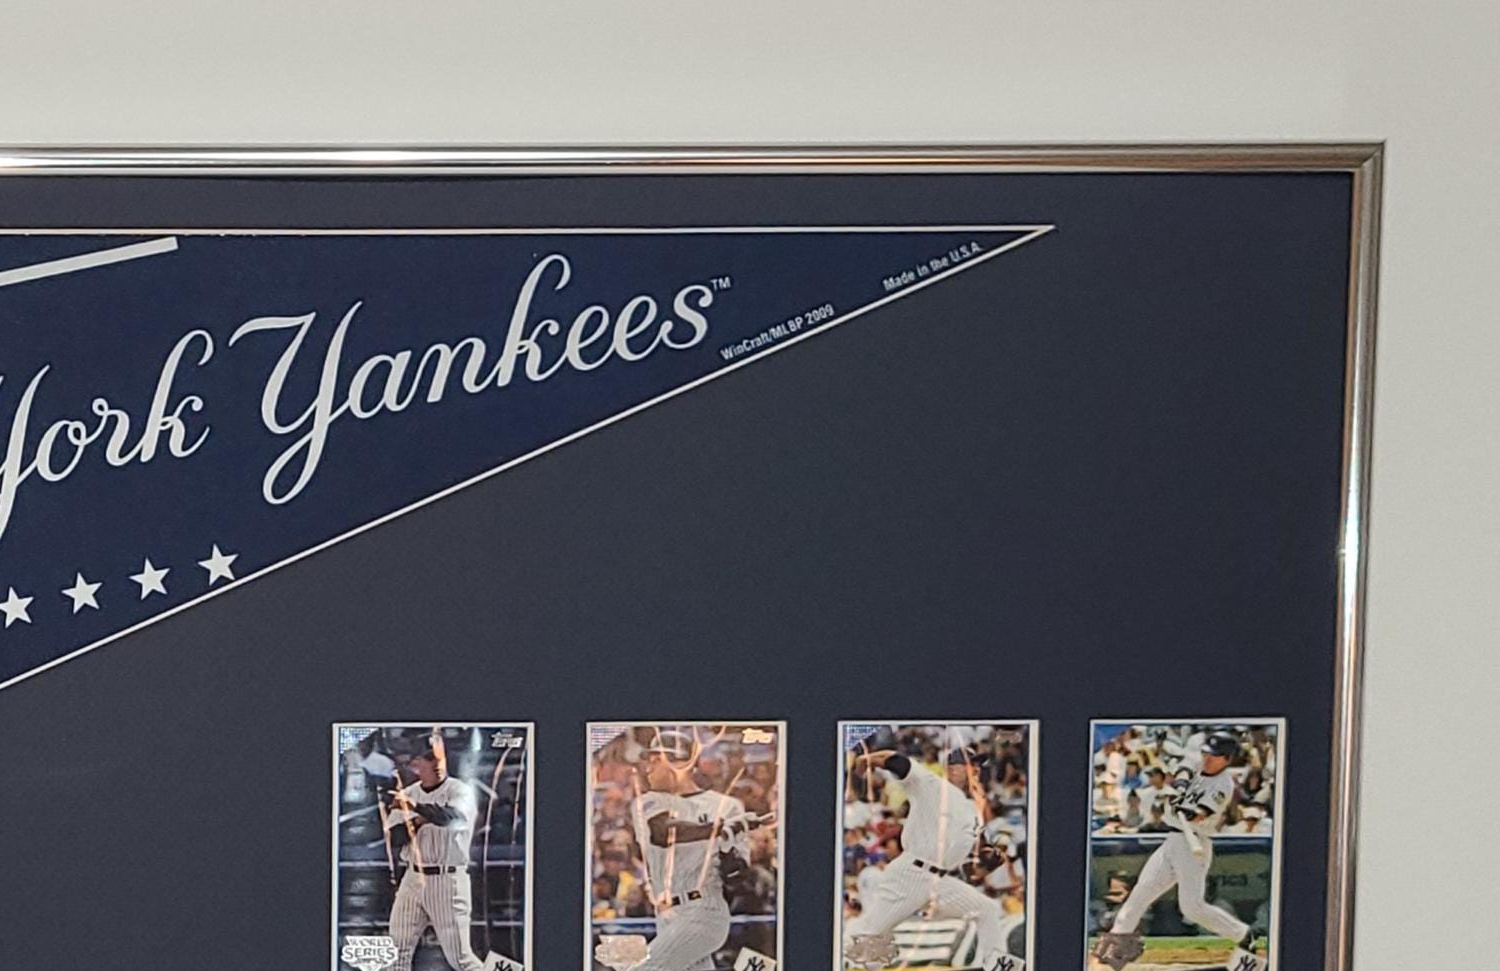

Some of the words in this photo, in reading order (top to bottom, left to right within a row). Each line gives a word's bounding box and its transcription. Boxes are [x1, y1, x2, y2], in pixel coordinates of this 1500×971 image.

[882, 271, 916, 292] Made
[916, 264, 930, 279] in
[929, 256, 950, 276] the
[228, 253, 714, 505] Yankees
